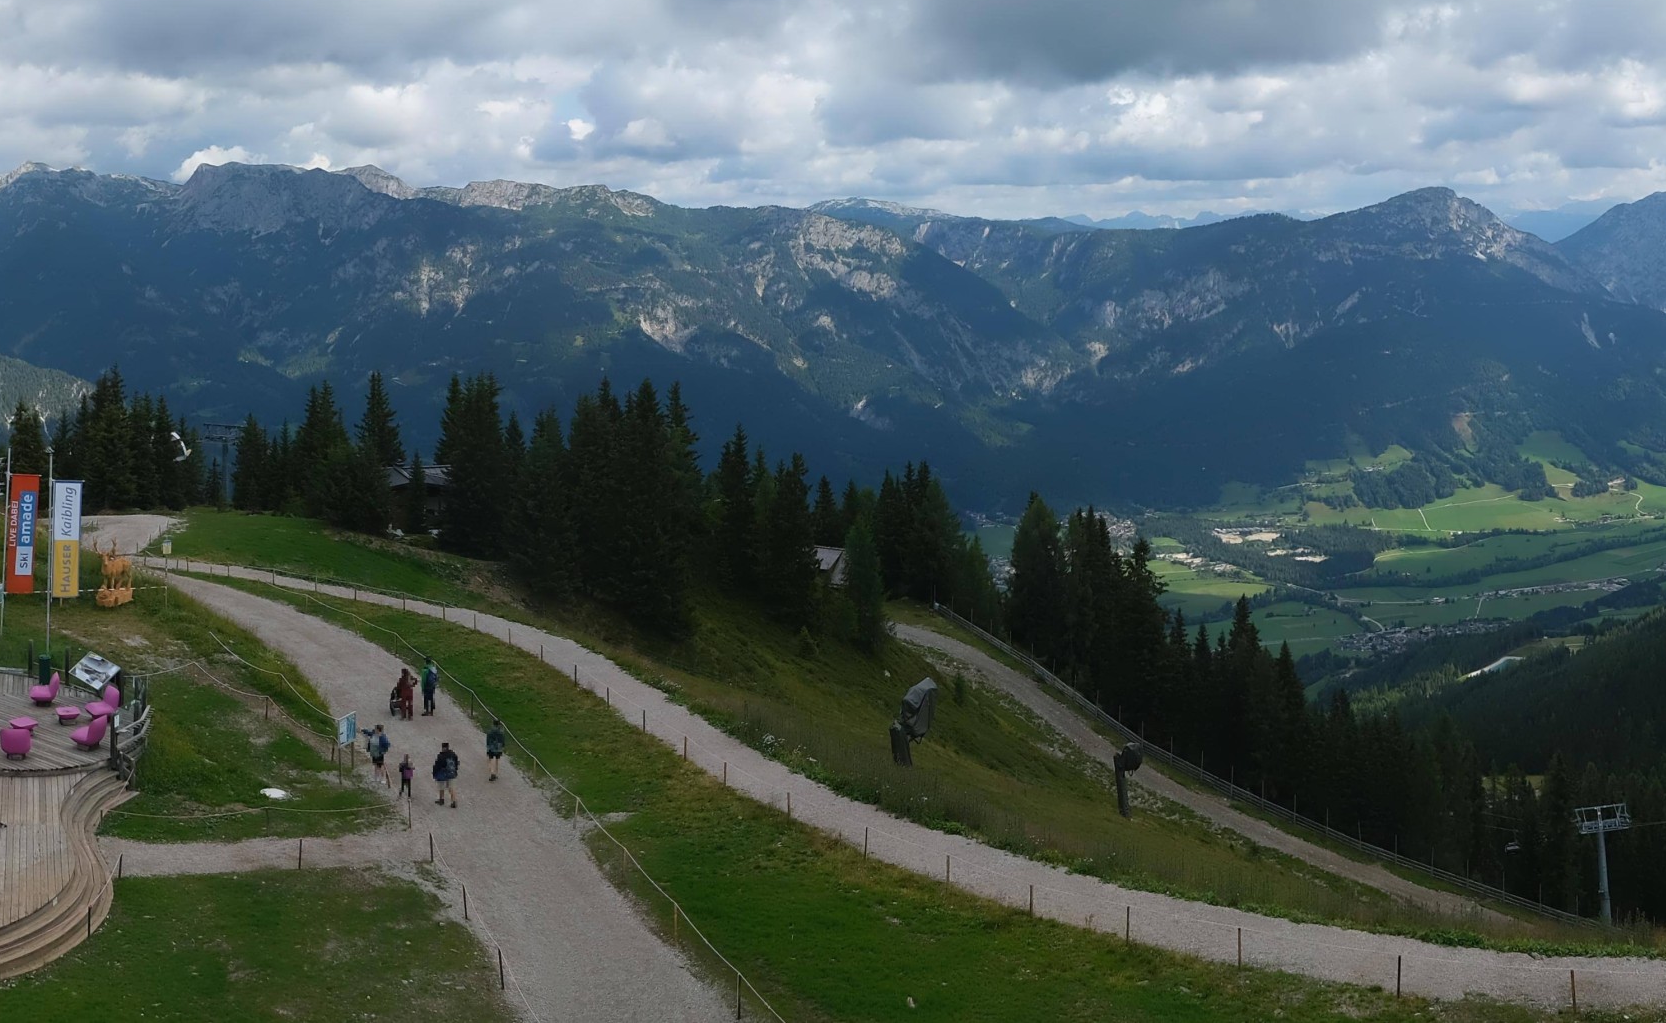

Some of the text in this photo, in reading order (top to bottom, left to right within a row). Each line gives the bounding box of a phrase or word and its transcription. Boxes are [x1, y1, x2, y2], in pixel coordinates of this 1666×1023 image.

[8, 501, 19, 547] LIVE DABEI
[19, 494, 33, 569] Ski amade
[61, 487, 77, 592] HAUSER Kaibling
